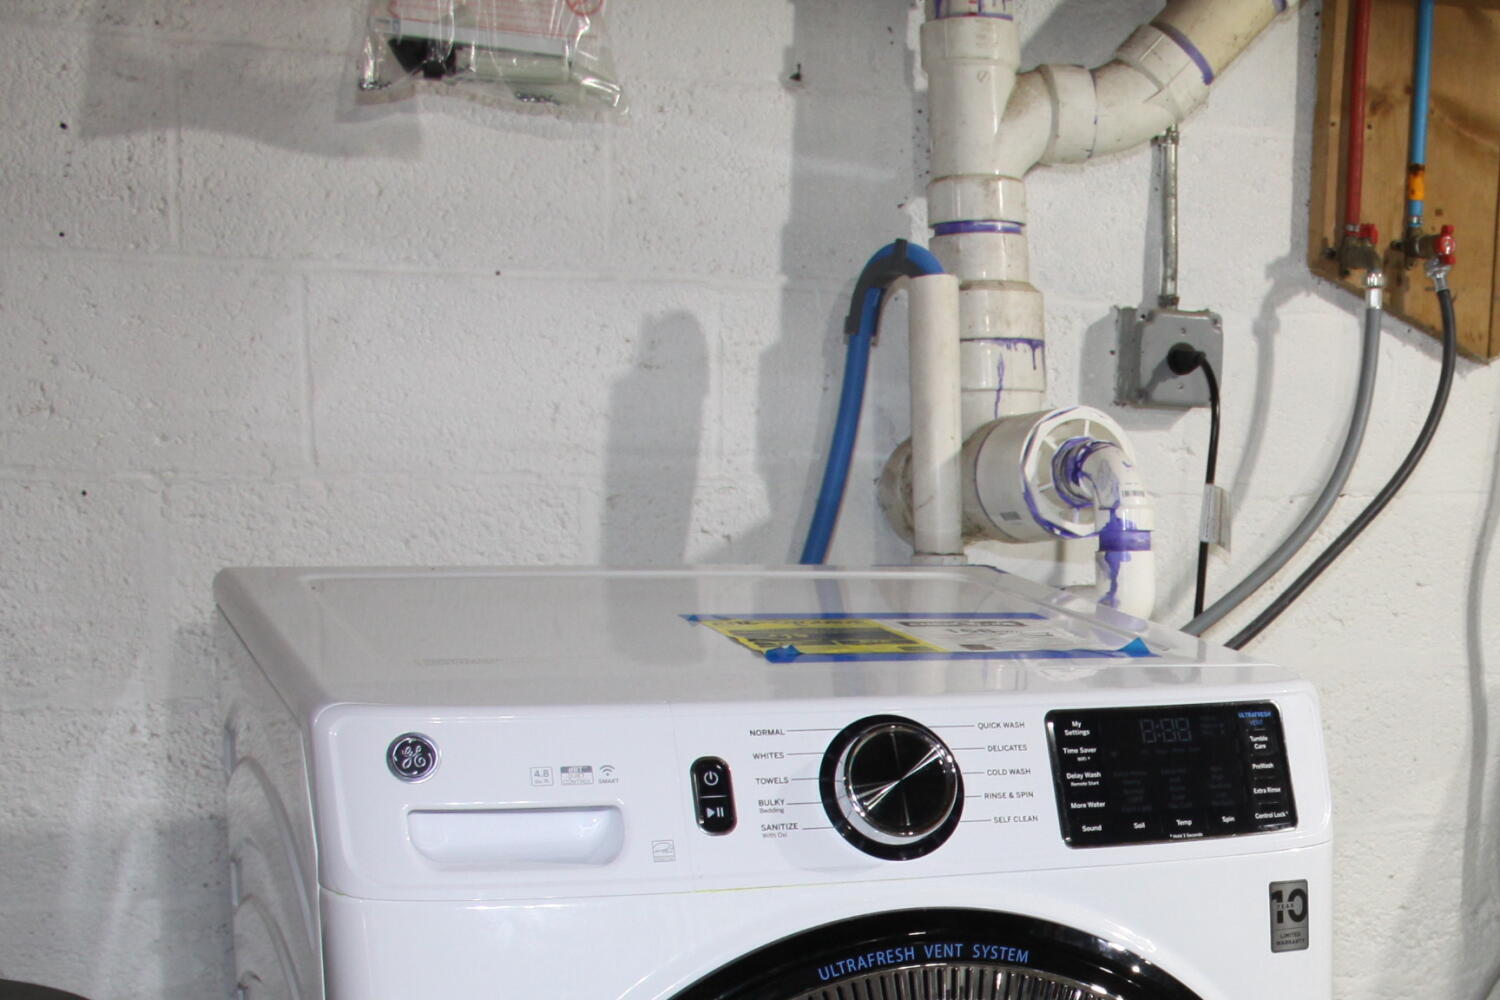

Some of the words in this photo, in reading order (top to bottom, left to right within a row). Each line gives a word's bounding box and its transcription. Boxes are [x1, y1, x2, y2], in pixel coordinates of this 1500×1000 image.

[977, 722, 1001, 730] QUICK
[1003, 721, 1025, 729] WASH
[749, 728, 785, 737] NORMAL
[987, 744, 1028, 752] DELICATES
[752, 751, 785, 760] WHITES
[1009, 768, 1031, 776] WASH
[1084, 771, 1102, 779] Wash
[756, 776, 790, 785] TOWELS
[984, 792, 1007, 800] RINSE
[1015, 791, 1034, 799] SPIN
[758, 799, 785, 807] BULKY
[993, 816, 1012, 824] SELF
[1013, 815, 1038, 823] CLEAN
[1176, 819, 1193, 827] Temp
[760, 823, 799, 832] SANITIZE
[1271, 888, 1307, 924] 10
[818, 946, 915, 981] ULTRAFRESH
[923, 943, 964, 960] VENT
[971, 943, 1030, 964] SYSTEM
